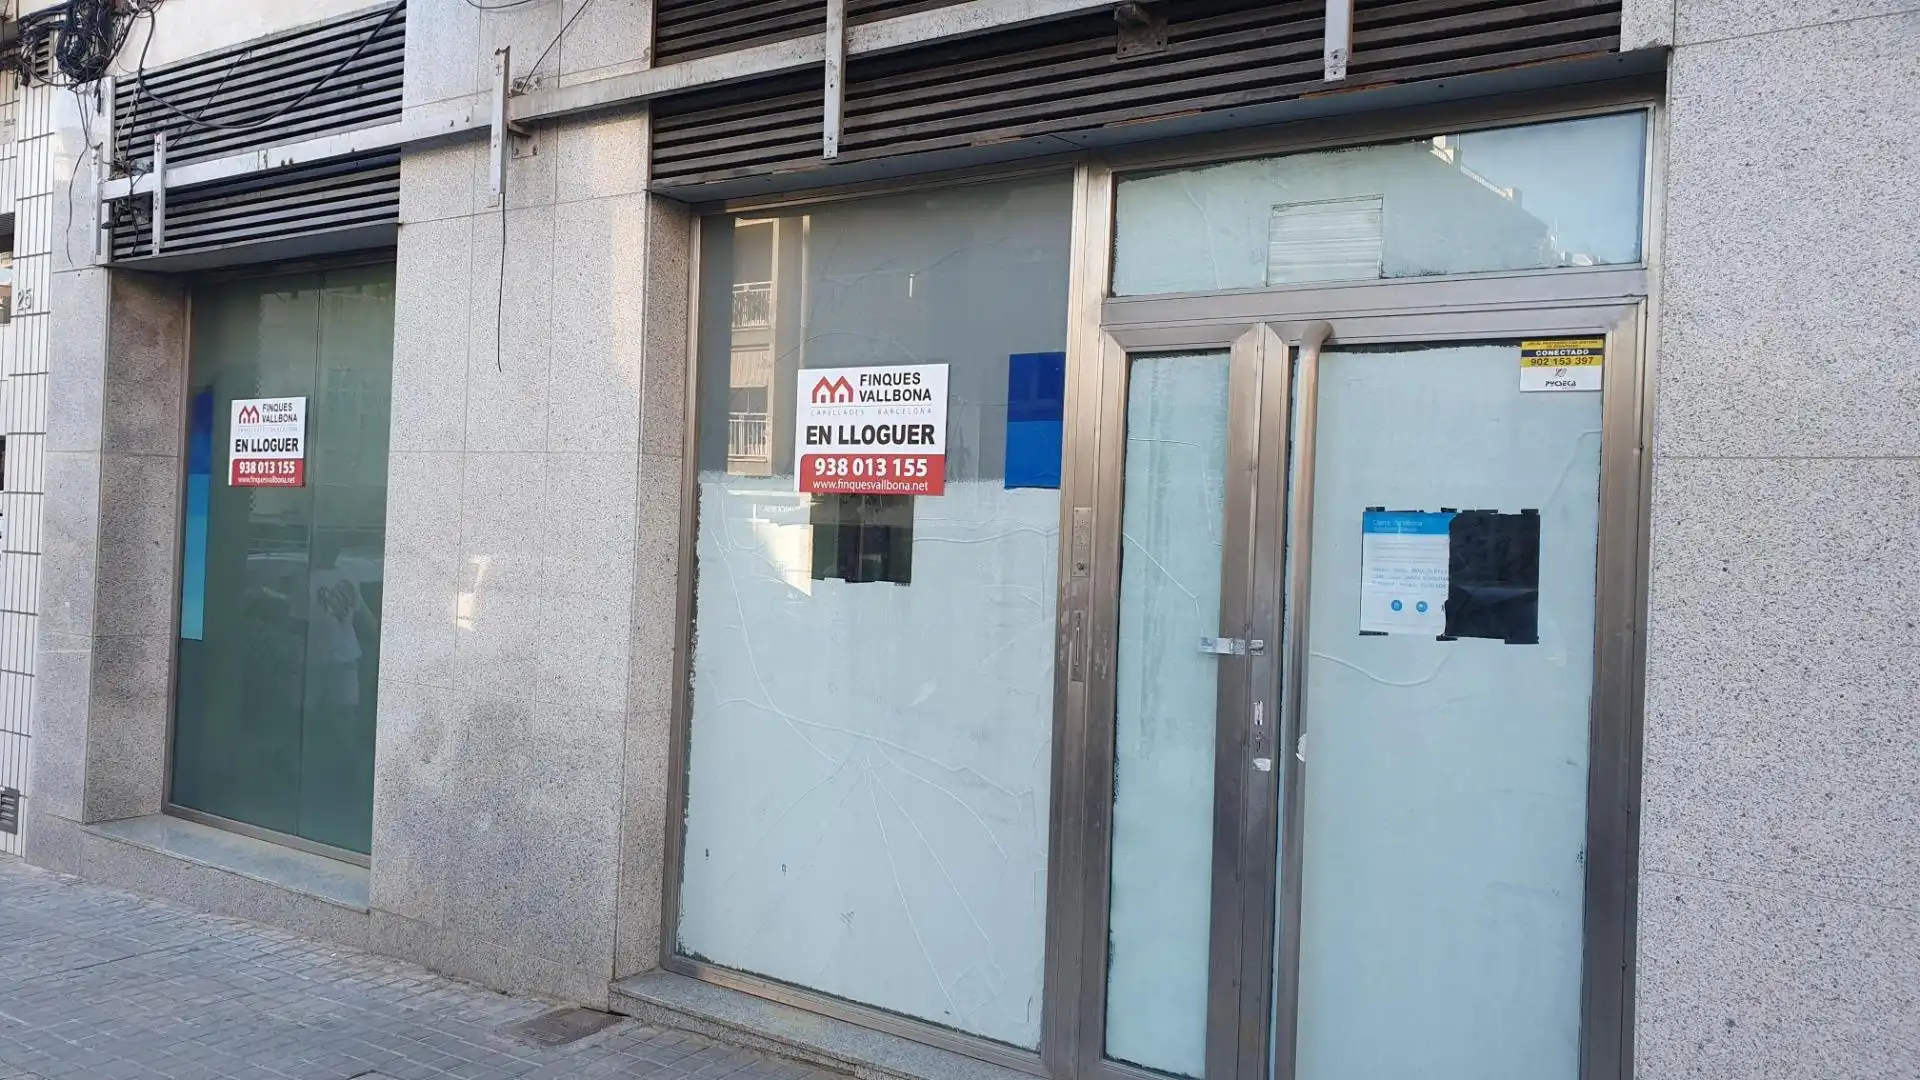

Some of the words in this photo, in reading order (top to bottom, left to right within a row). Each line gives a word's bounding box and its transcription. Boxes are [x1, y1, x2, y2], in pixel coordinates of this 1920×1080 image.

[1530, 358, 1549, 366] 902
[1552, 358, 1572, 366] 153
[859, 372, 921, 386] FINQUES
[859, 388, 932, 403] VALLBONA
[262, 403, 293, 412] FINQUES
[810, 408, 864, 416] CAPELLADES
[878, 408, 933, 416] BARCELONA
[262, 414, 297, 423] VALLBONA
[806, 425, 832, 445] EN
[838, 424, 935, 445] LLOGUER
[235, 439, 248, 452] EN
[251, 438, 298, 452] LLOGUER
[239, 461, 256, 474] 938
[258, 461, 275, 474] 013
[278, 461, 295, 474] 155
[814, 458, 848, 476] 938
[852, 458, 887, 477] 013
[892, 459, 927, 477] 155
[813, 479, 929, 492] www.finquesvallbona.net
